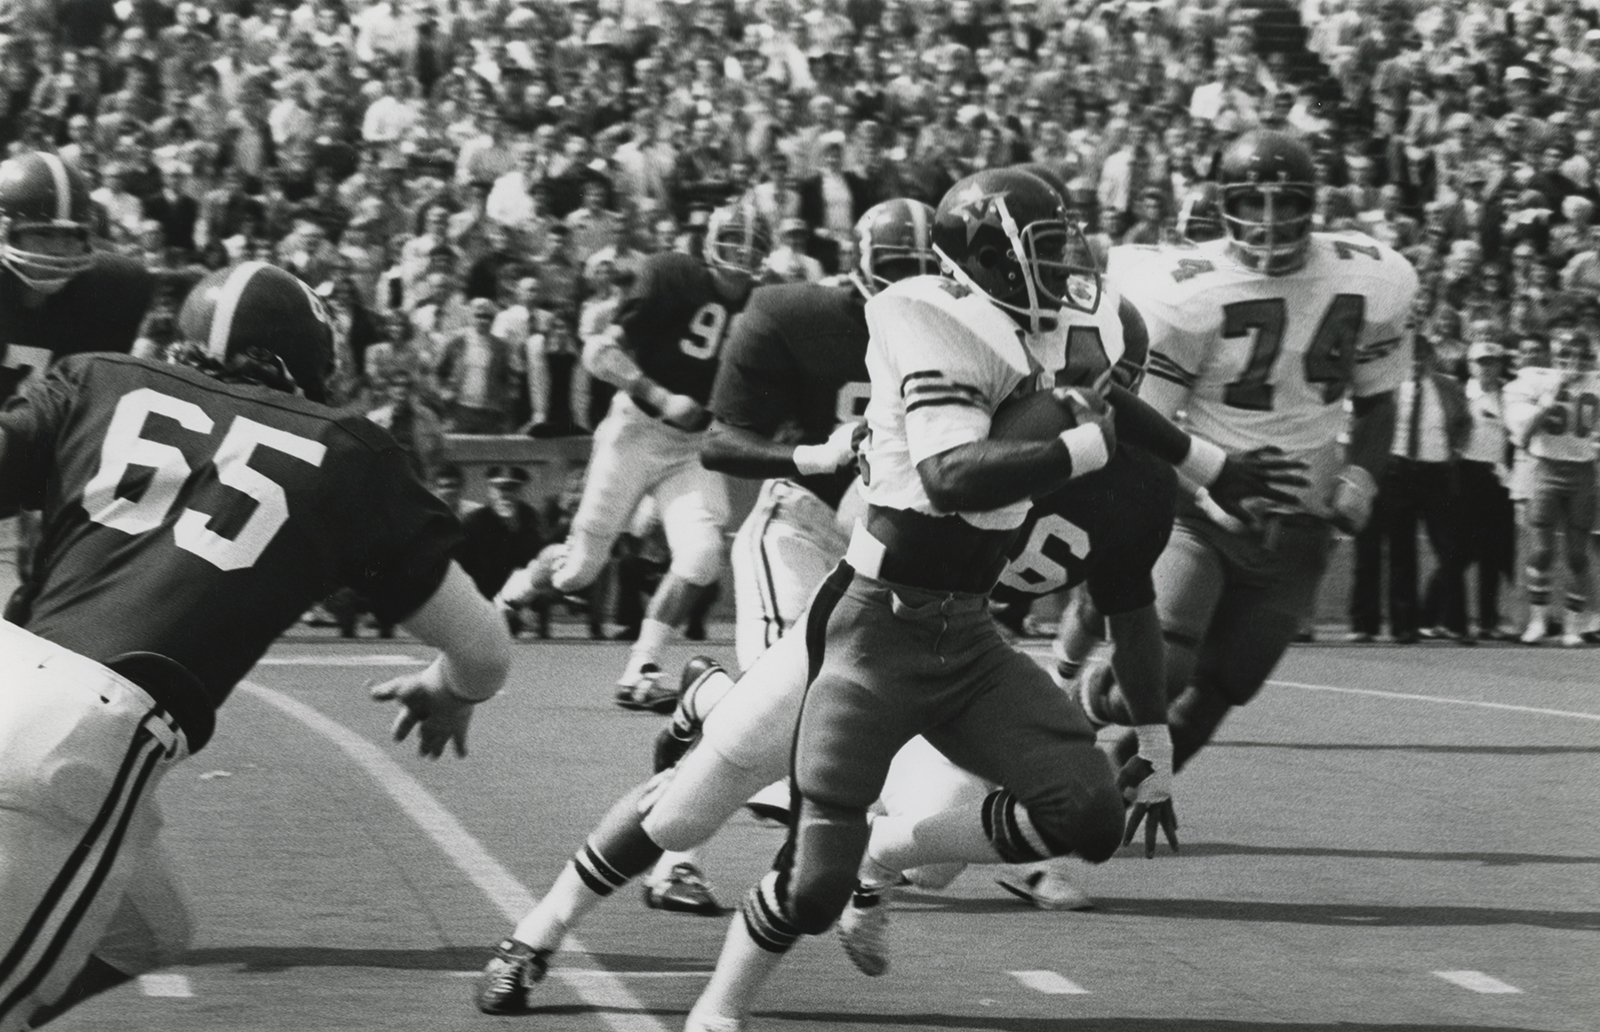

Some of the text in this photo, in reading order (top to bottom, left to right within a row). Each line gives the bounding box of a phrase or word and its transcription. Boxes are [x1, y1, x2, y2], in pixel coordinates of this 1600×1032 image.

[681, 302, 726, 359] 9
[1222, 293, 1365, 411] 74
[83, 387, 327, 571] 65
[998, 514, 1091, 594] 6
